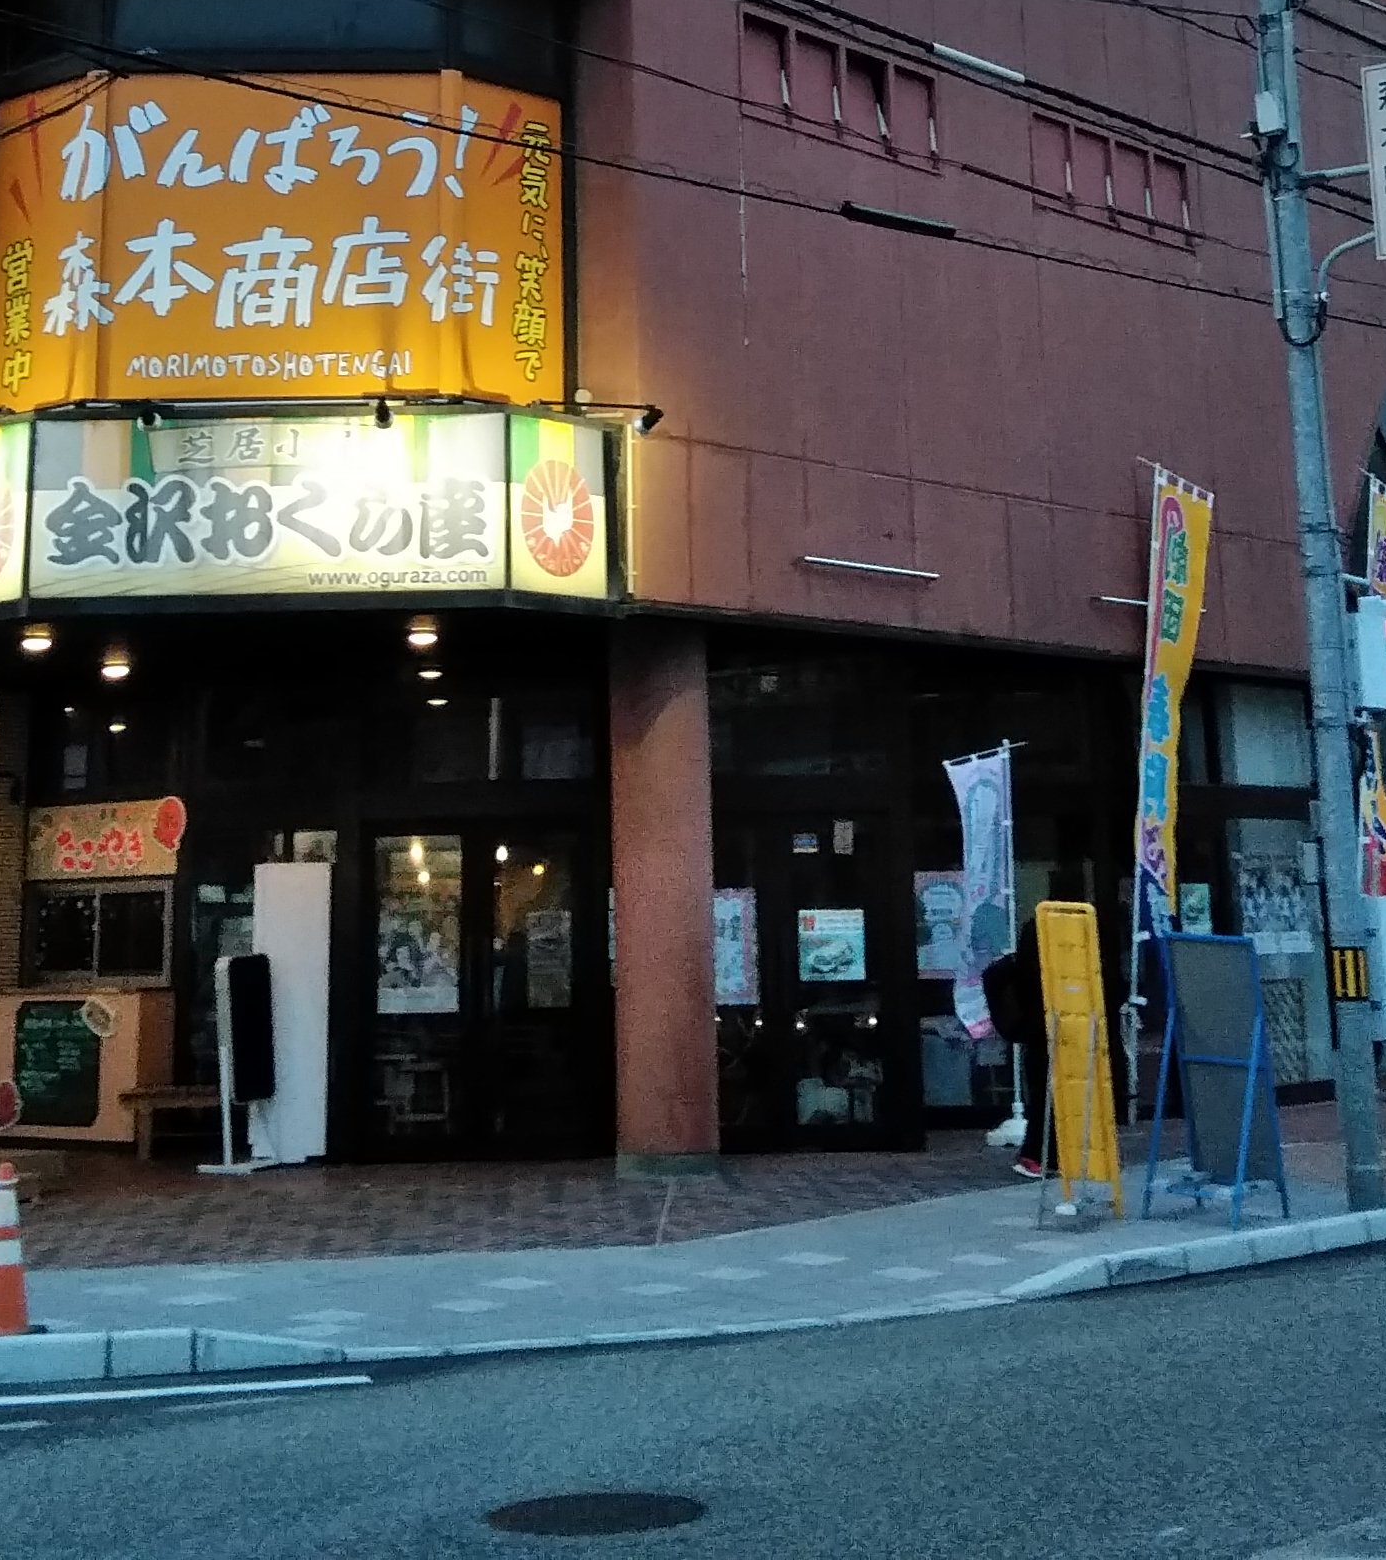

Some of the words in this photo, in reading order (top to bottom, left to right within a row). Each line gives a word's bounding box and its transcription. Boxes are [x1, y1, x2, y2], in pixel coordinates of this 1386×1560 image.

[42, 216, 501, 335] 森本商店街
[1, 239, 34, 396] 営業中
[125, 349, 413, 381] MORIMOTOSHOTENGAI
[178, 425, 355, 466] 芝居小
[308, 567, 488, 588] www.oguraza.com
